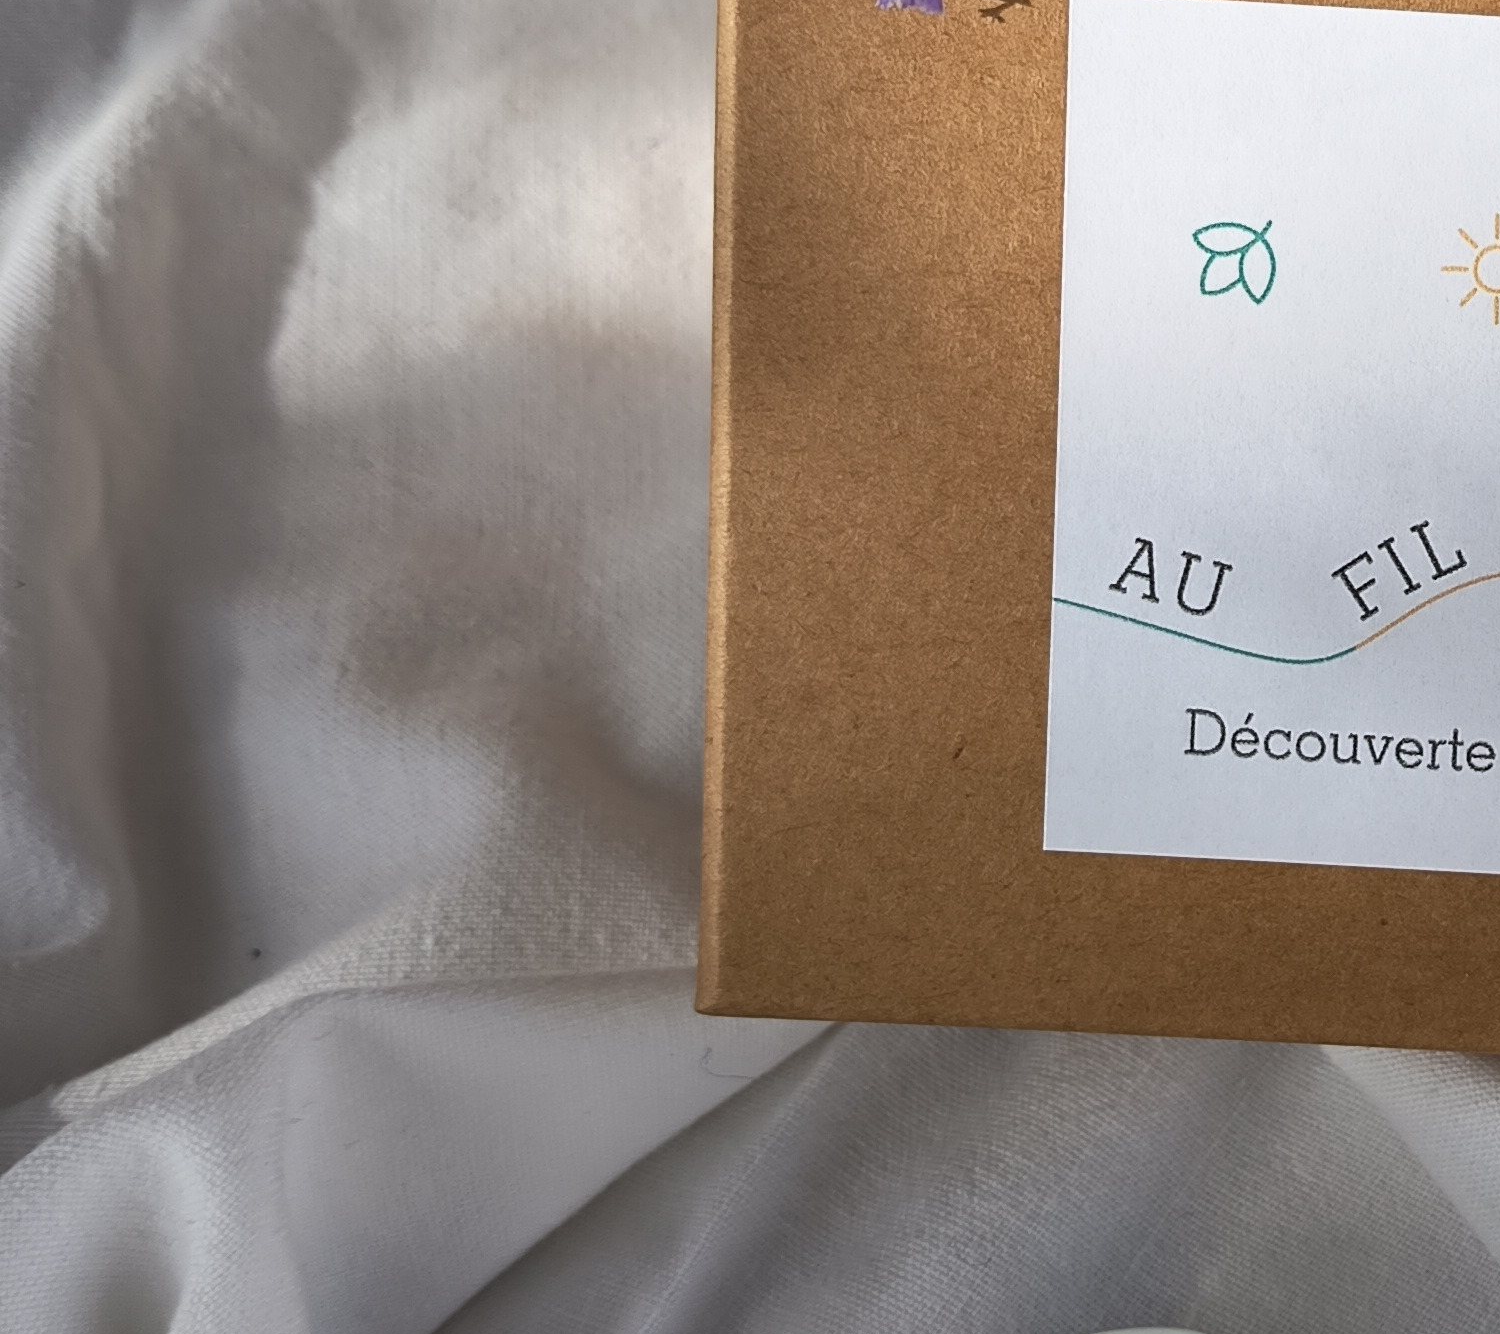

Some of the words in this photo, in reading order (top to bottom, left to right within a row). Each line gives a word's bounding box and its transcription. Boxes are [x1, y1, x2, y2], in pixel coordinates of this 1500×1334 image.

[1111, 536, 1234, 617] AU
[1333, 517, 1468, 623] FIL
[1183, 706, 1497, 780] Découverte
